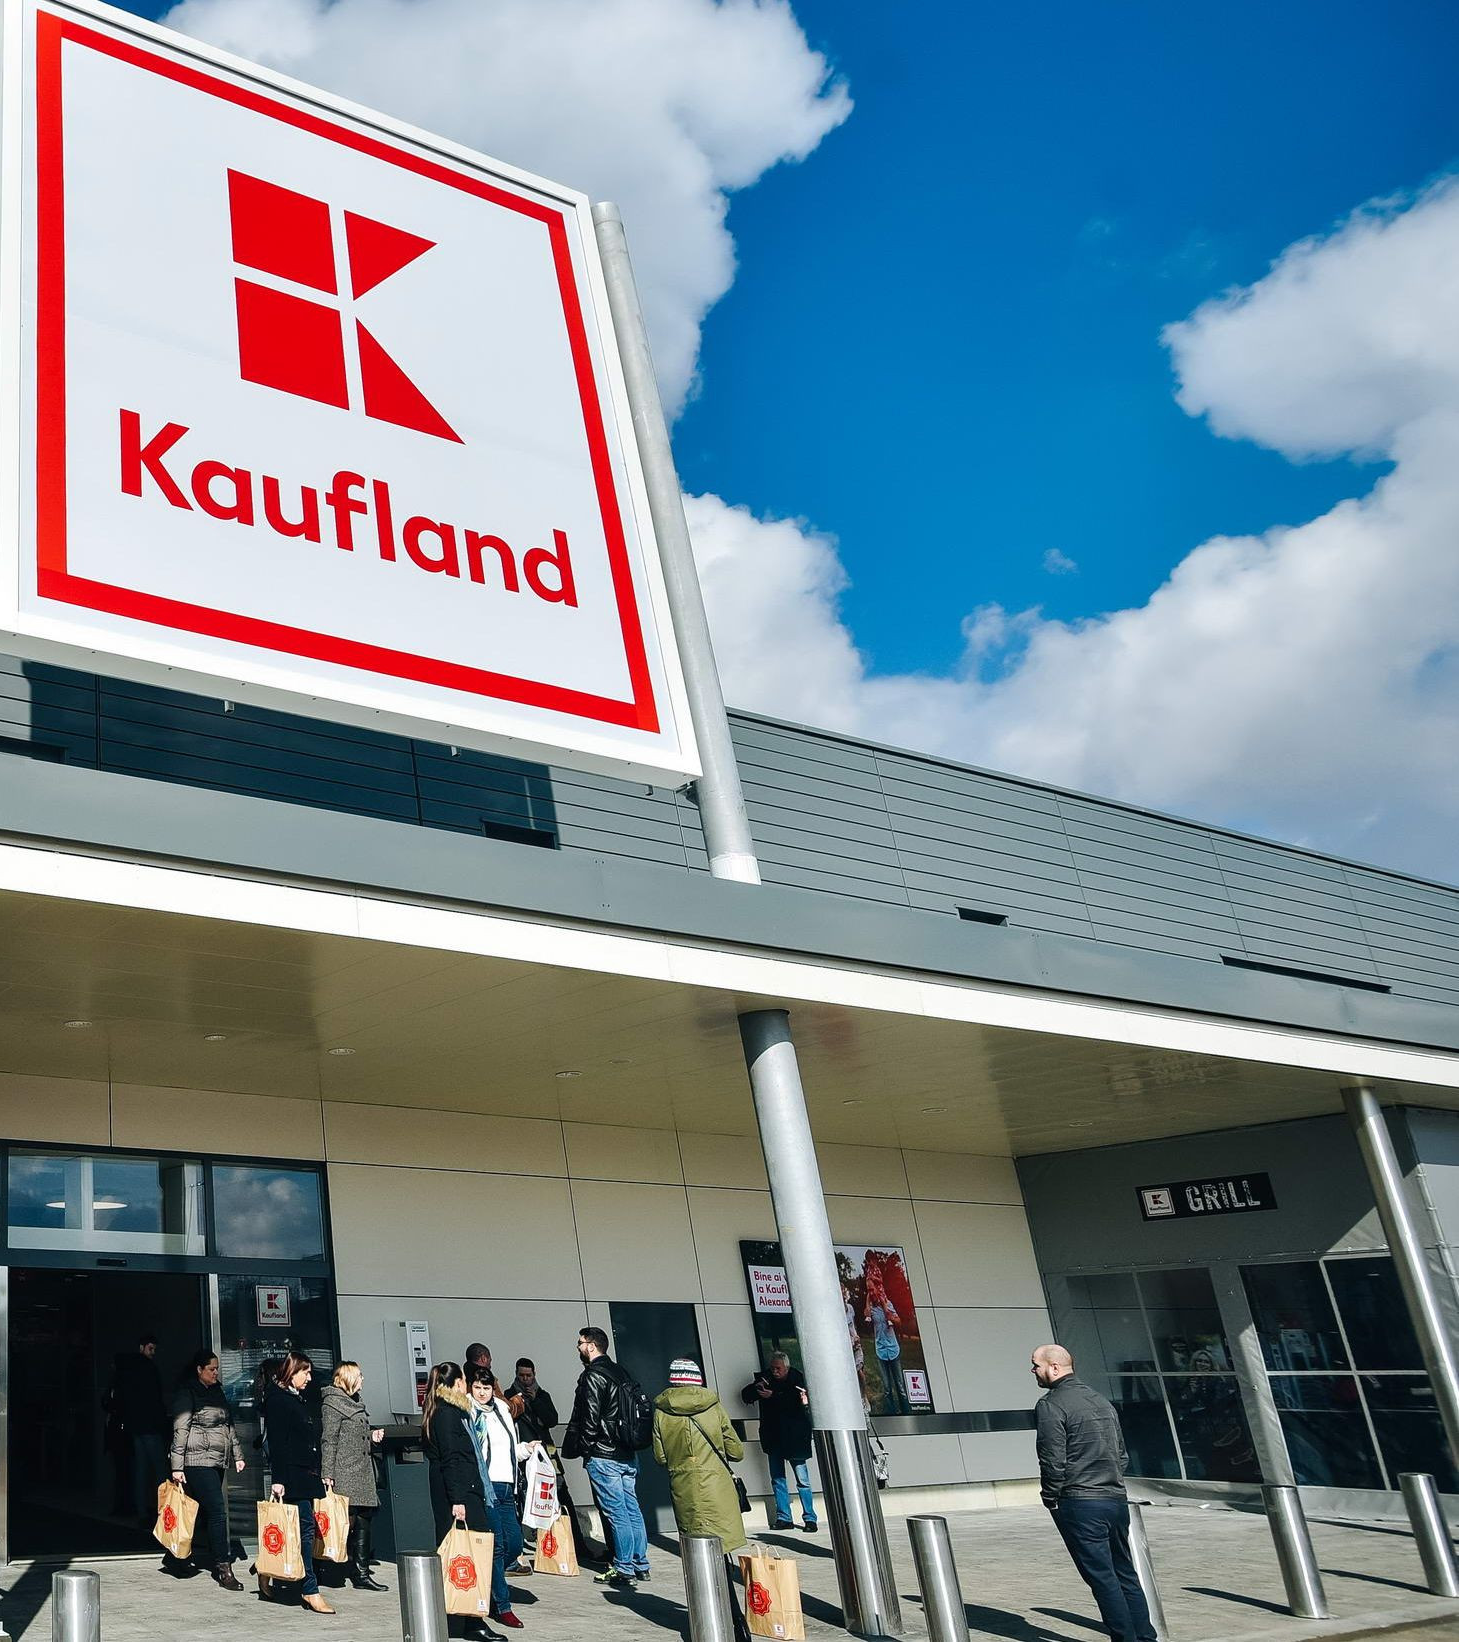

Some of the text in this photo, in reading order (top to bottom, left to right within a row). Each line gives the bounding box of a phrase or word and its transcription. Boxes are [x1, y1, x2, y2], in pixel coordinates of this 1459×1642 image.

[119, 408, 578, 608] Kaufland
[1185, 1180, 1260, 1212] GRILL
[754, 1271, 771, 1281] Bine
[774, 1272, 782, 1281] ai
[756, 1283, 788, 1294] la Kaufl
[759, 1296, 792, 1306] Alexand
